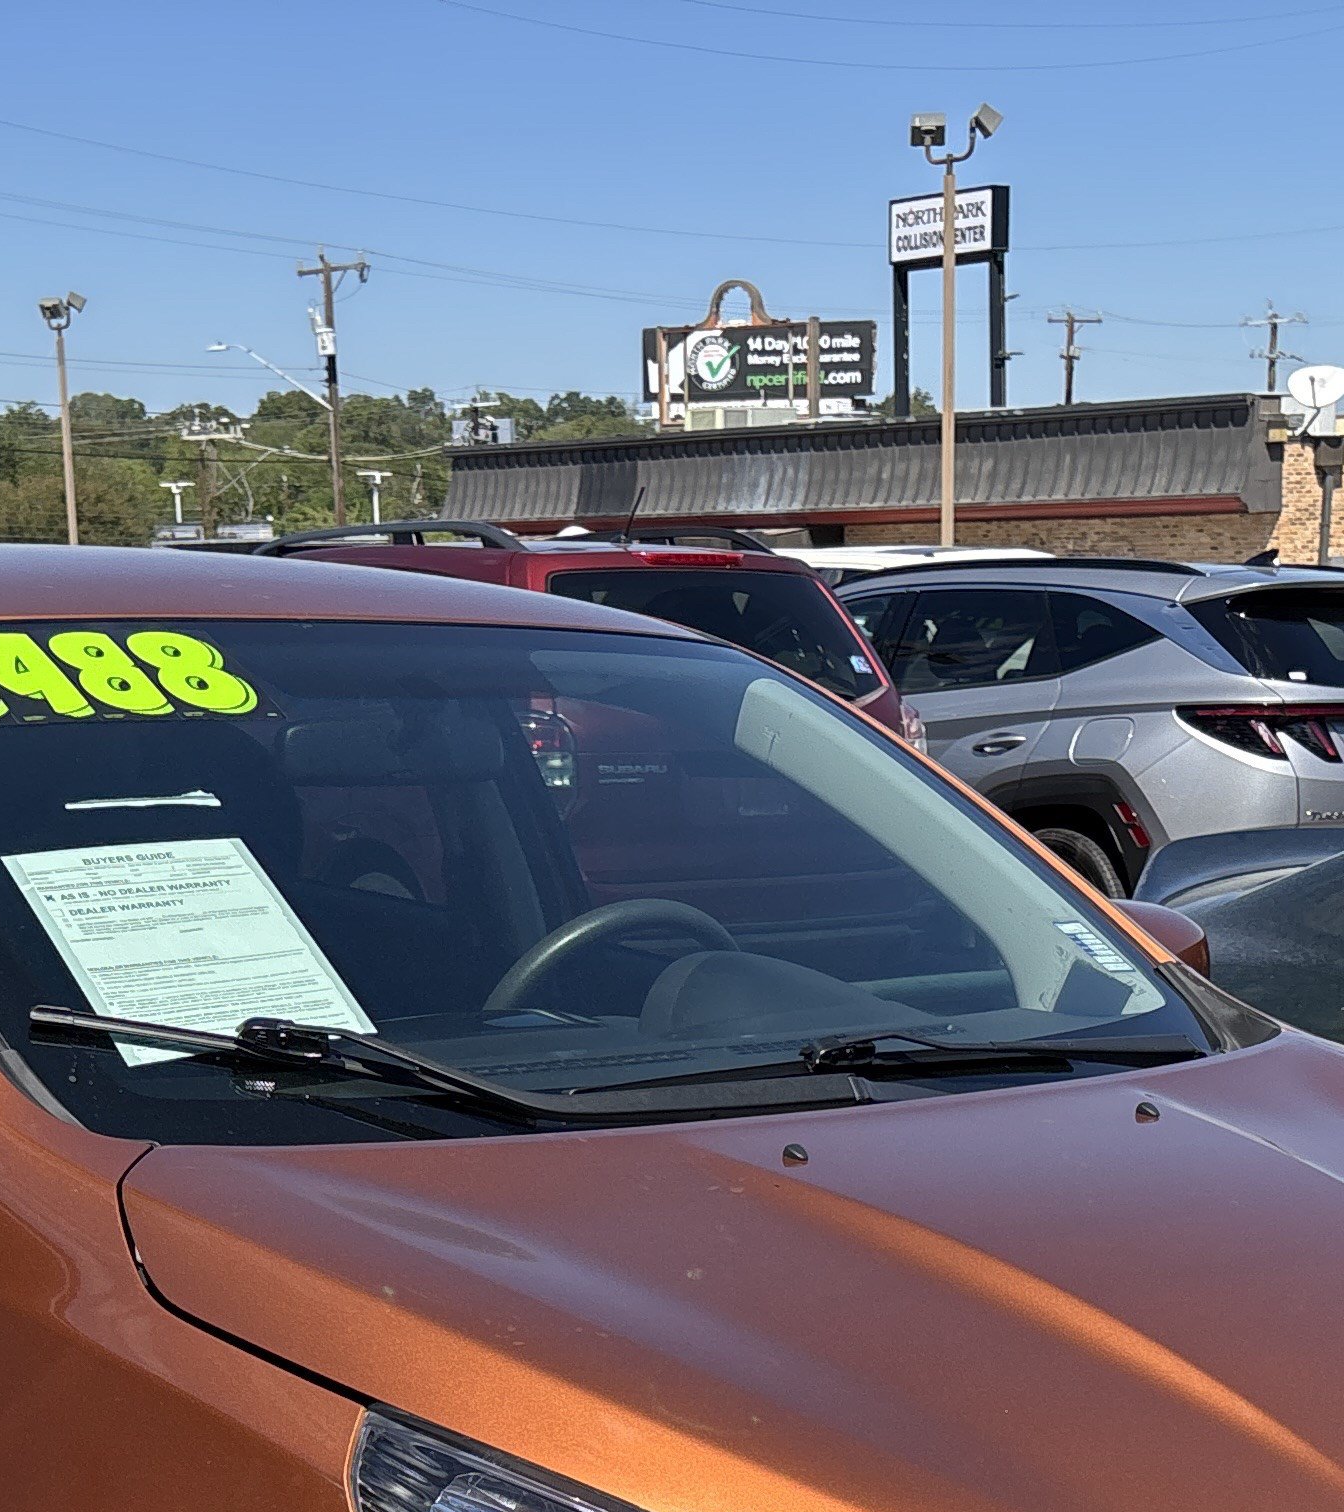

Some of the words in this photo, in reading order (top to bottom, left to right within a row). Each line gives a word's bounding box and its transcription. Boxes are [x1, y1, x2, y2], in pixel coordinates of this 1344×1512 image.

[896, 207, 944, 229] NORTH
[953, 201, 987, 221] ARK
[953, 224, 986, 245] ENTER
[831, 332, 861, 348] mile
[81, 855, 134, 866] BUYERS
[136, 852, 175, 862] GUIDE
[99, 889, 117, 898] NO
[118, 885, 165, 897] DEALER
[163, 879, 231, 892] WARRANTY
[68, 904, 118, 917] DEALER
[118, 899, 184, 912] WARRANTY
